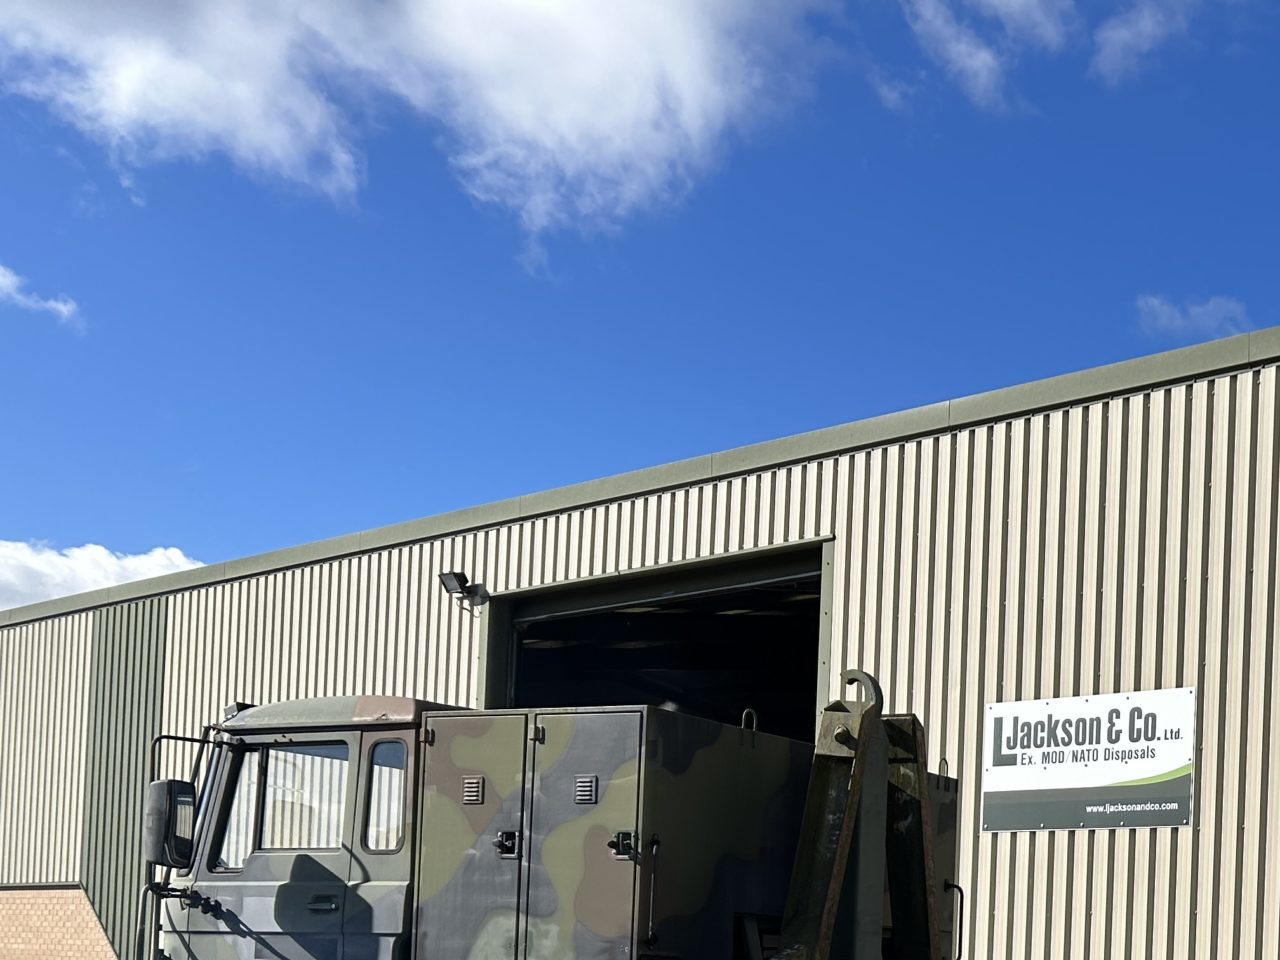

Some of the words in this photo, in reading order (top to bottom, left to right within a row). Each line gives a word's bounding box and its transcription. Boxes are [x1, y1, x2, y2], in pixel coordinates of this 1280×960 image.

[1107, 708, 1122, 744] &
[1129, 707, 1161, 743] Co.
[1164, 728, 1183, 741] Ltd.
[1021, 753, 1036, 766] Ex.
[1042, 749, 1099, 765] MOD/NATO
[1104, 746, 1156, 763] Disposals
[1085, 801, 1179, 814] www.ljacksonandco.com
